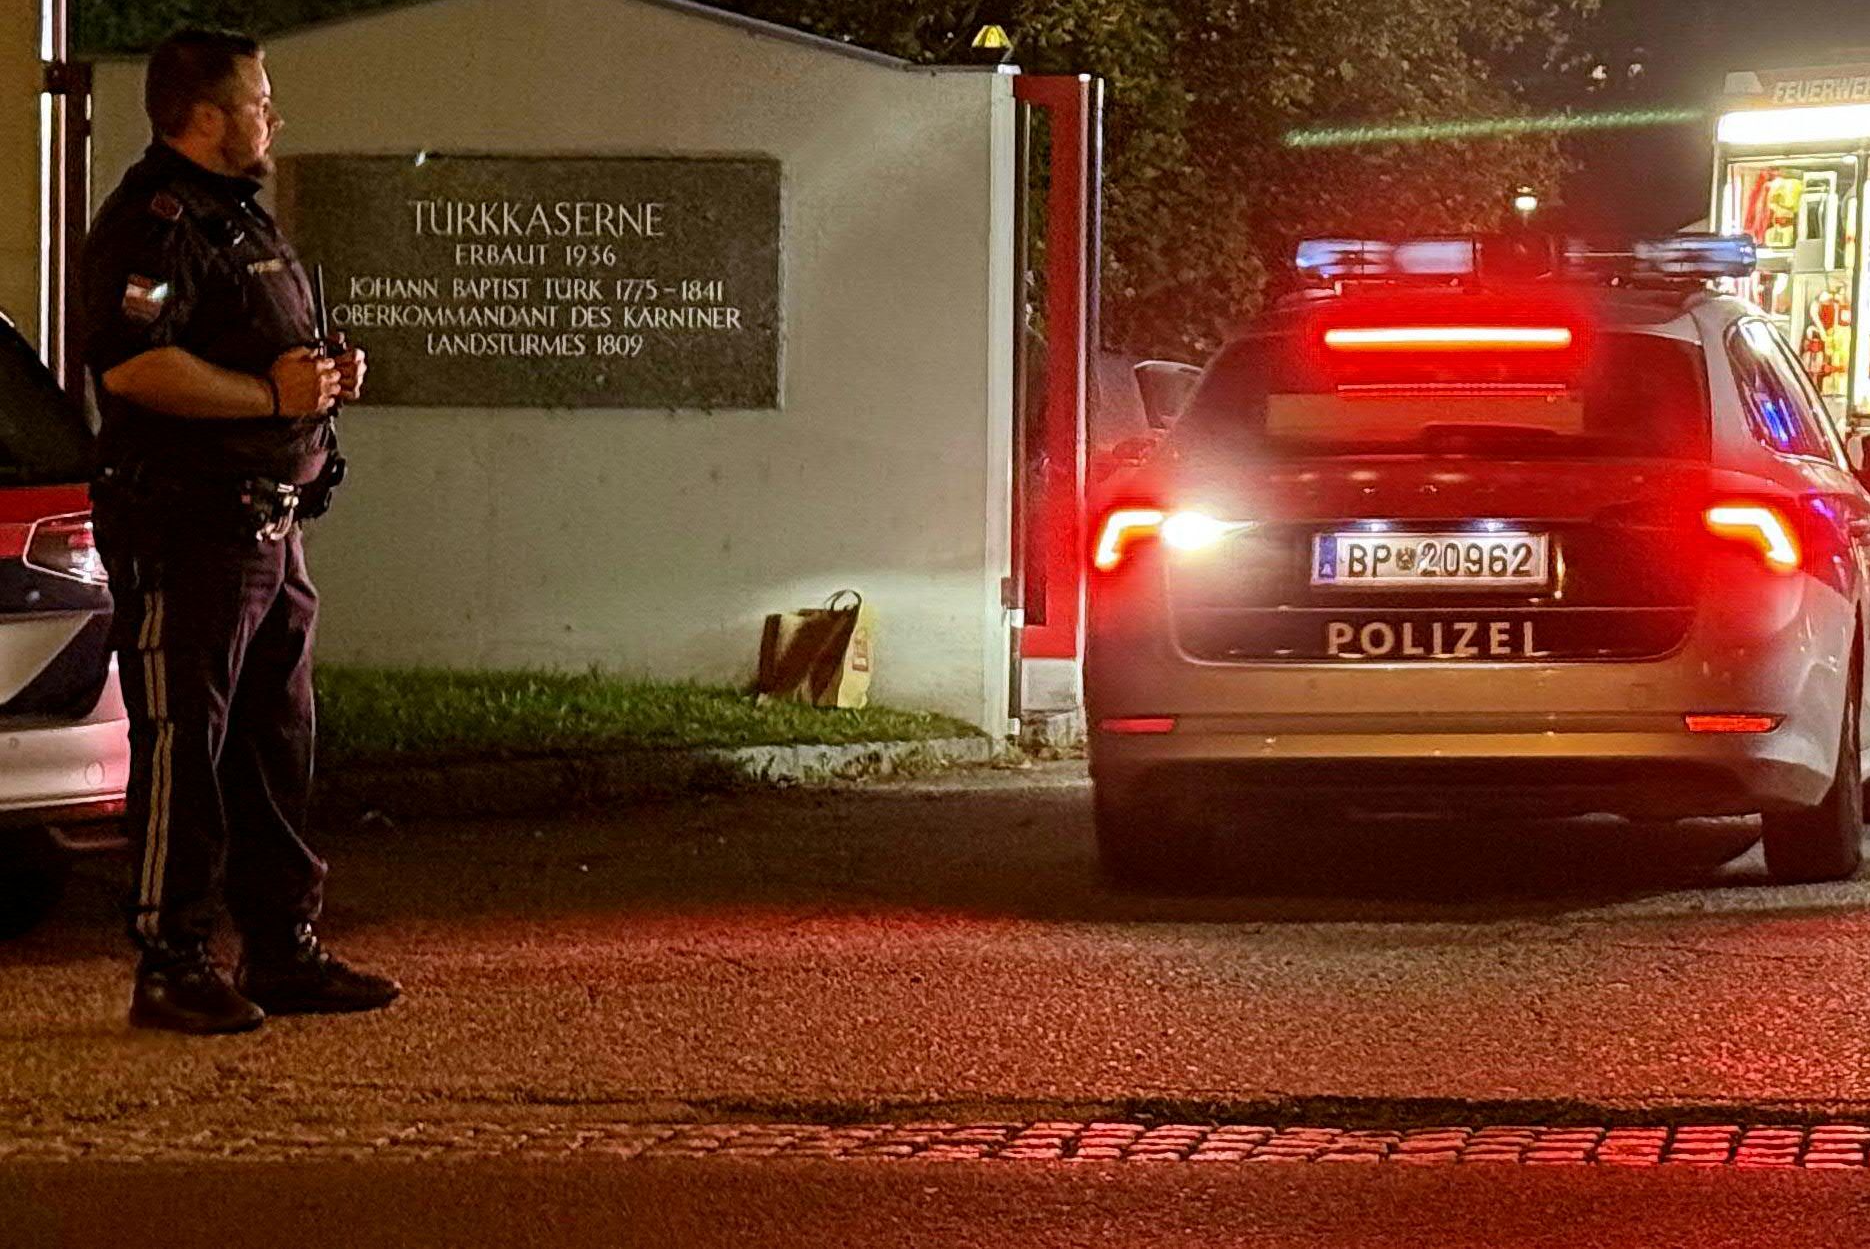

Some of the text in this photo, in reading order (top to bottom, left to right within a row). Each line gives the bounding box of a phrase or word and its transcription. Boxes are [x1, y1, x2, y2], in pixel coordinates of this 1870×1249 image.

[455, 244, 617, 267] ERBAUT 1936
[350, 277, 439, 300] JOHANN
[452, 277, 530, 300] BAPTIST
[331, 303, 559, 328] OBERKOMMANDANT
[571, 305, 613, 328] DES
[427, 332, 644, 357] LANDSTURMES 1809
[1348, 542, 1533, 578] BP 20962
[1327, 621, 1536, 655] POLIZEI
